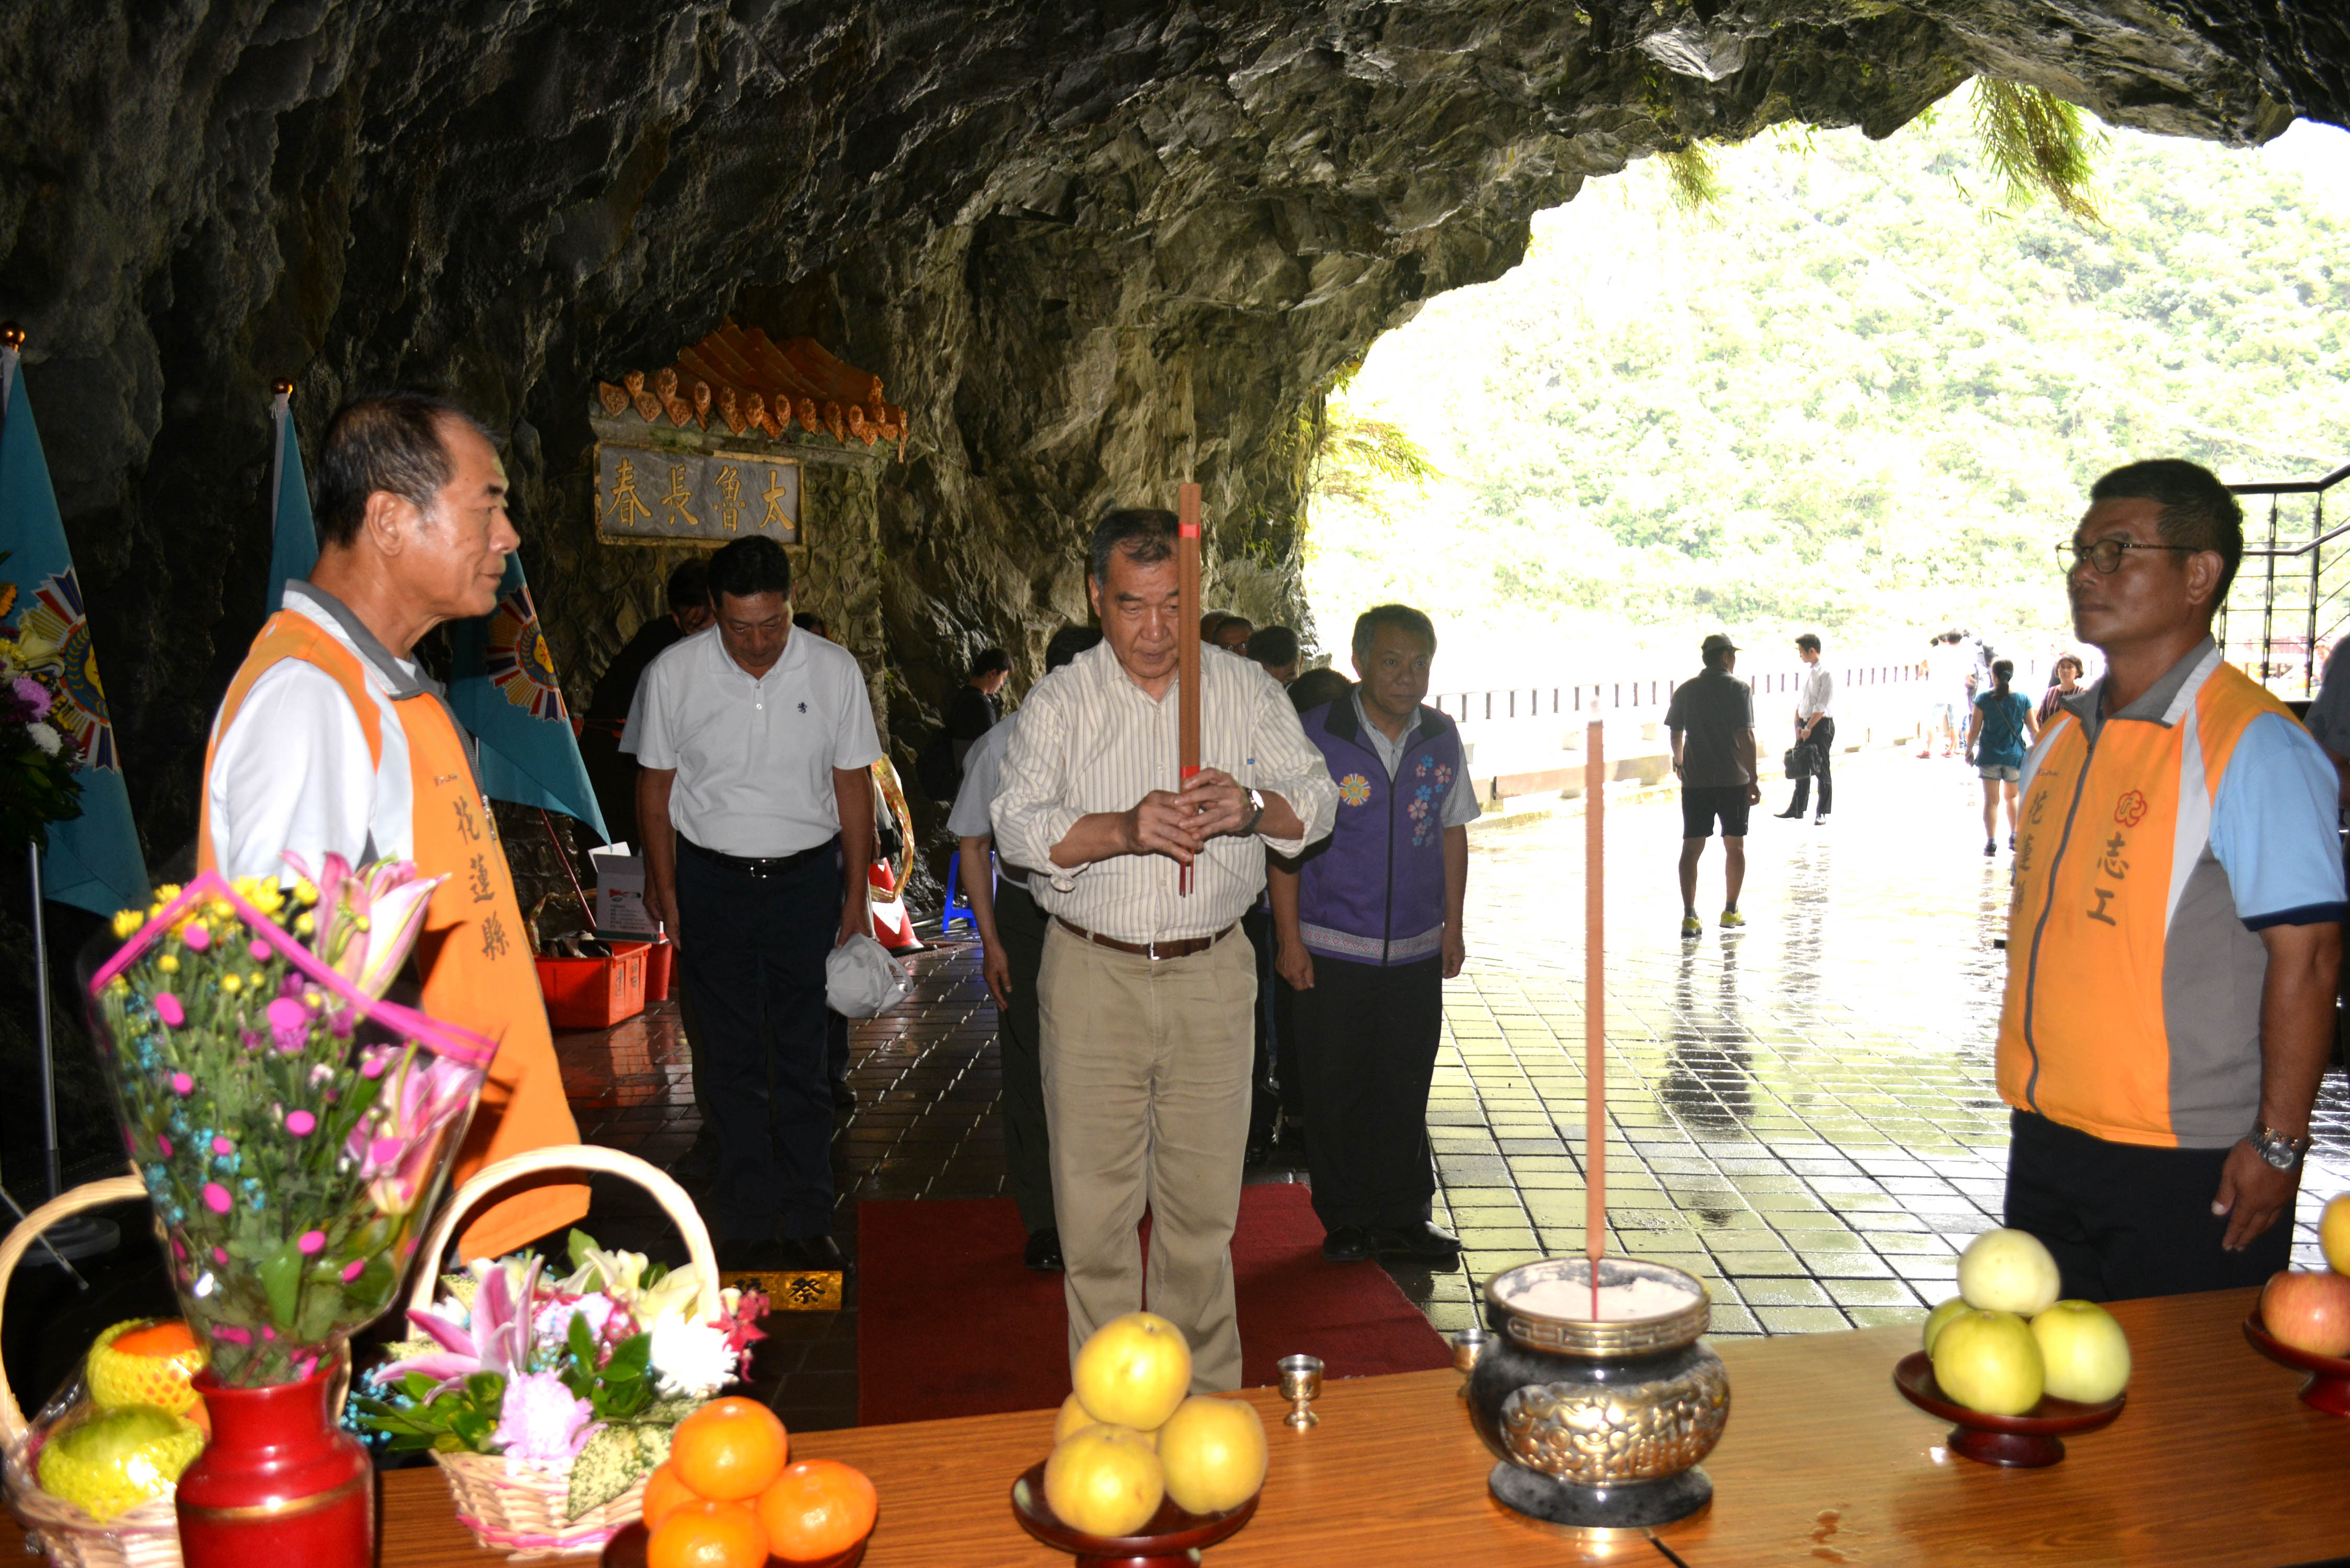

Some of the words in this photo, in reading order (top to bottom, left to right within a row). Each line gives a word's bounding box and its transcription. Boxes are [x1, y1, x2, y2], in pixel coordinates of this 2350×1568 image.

[453, 795, 510, 961] 花蓮縣
[2086, 831, 2129, 926] 志工
